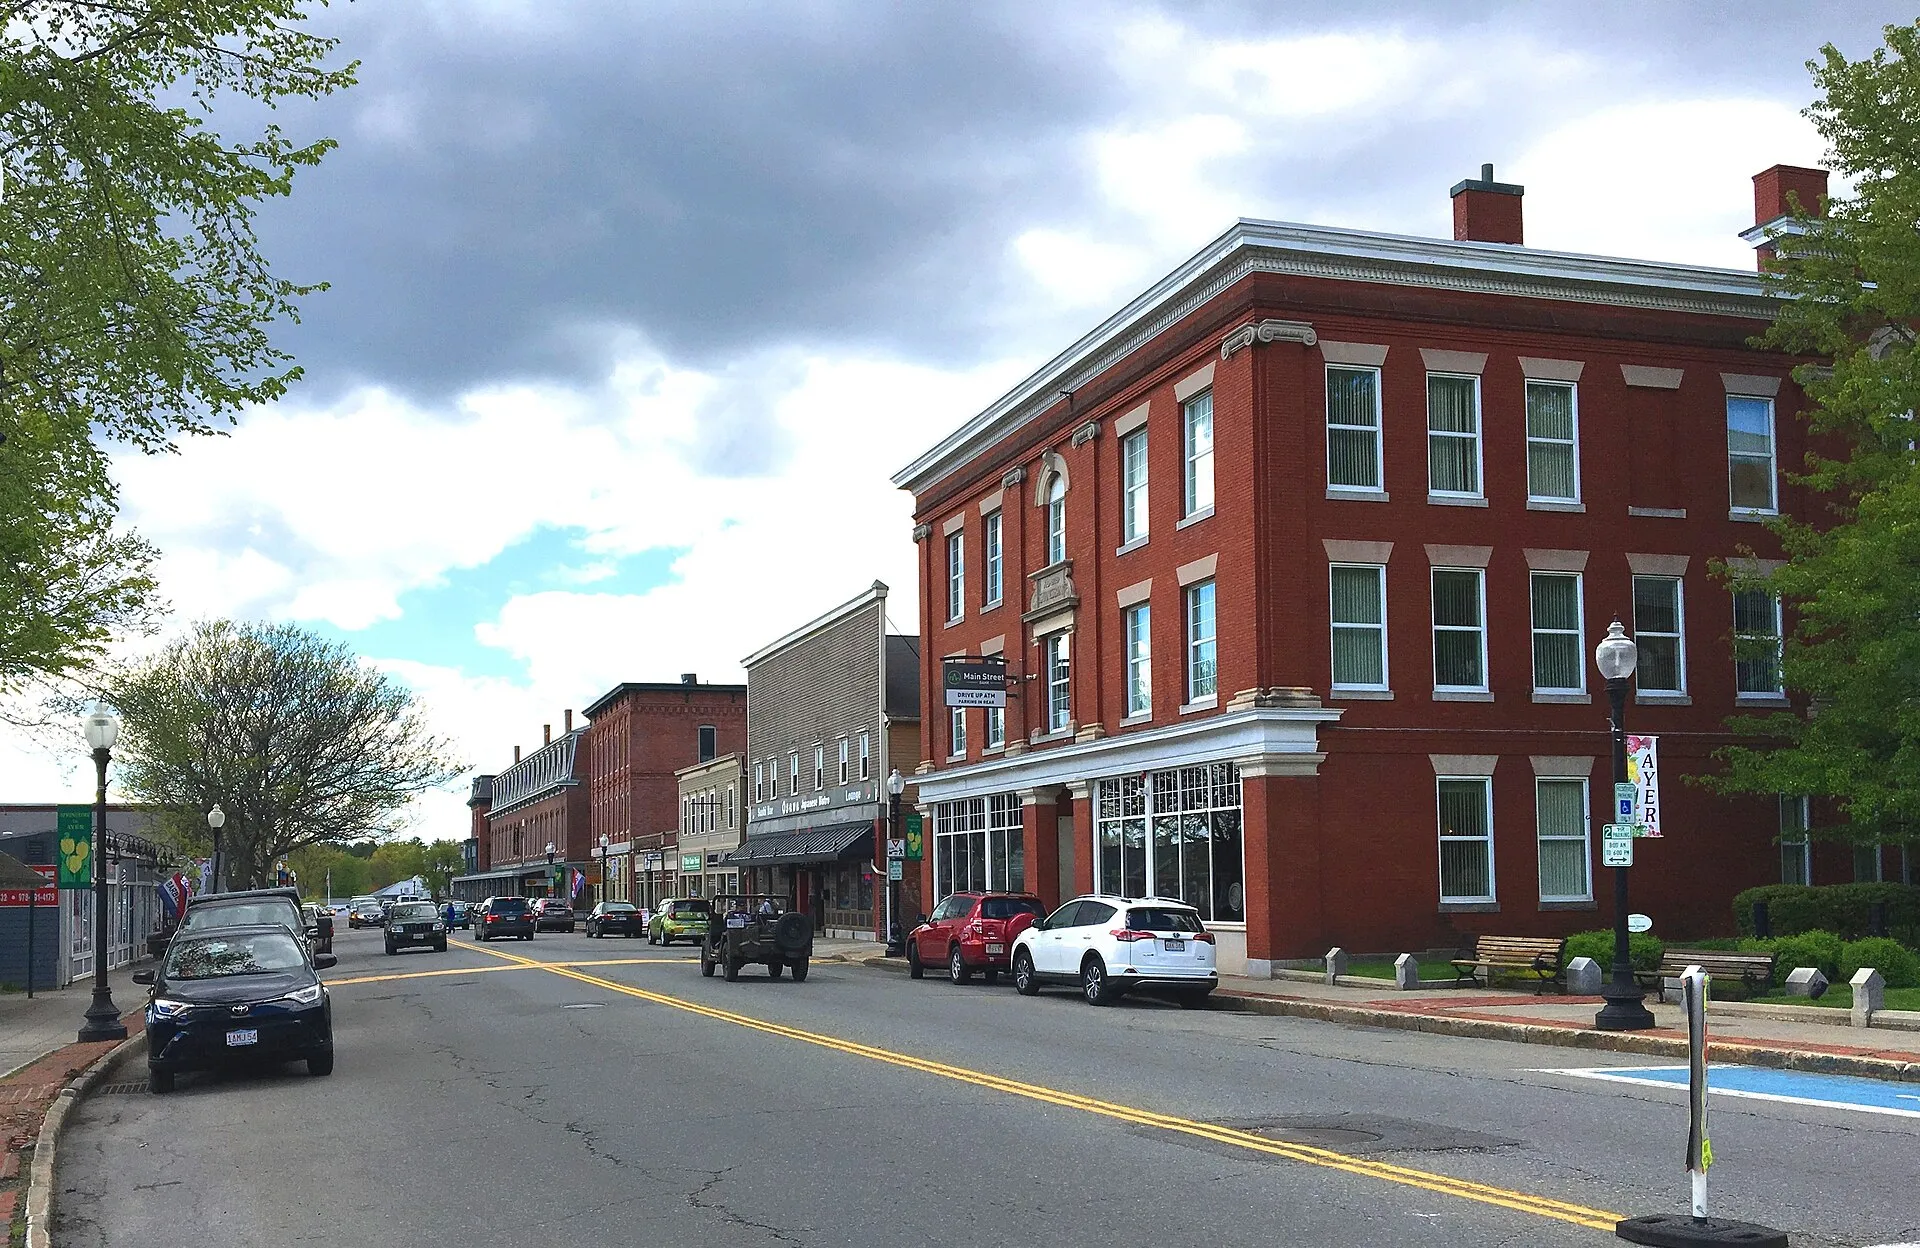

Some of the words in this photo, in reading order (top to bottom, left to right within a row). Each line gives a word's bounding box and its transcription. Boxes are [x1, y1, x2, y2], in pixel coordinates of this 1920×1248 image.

[963, 672, 981, 680] Main
[982, 672, 1005, 681] Street
[1641, 753, 1657, 823] AYER
[845, 789, 862, 802] Lounge
[1604, 827, 1612, 839] 2
